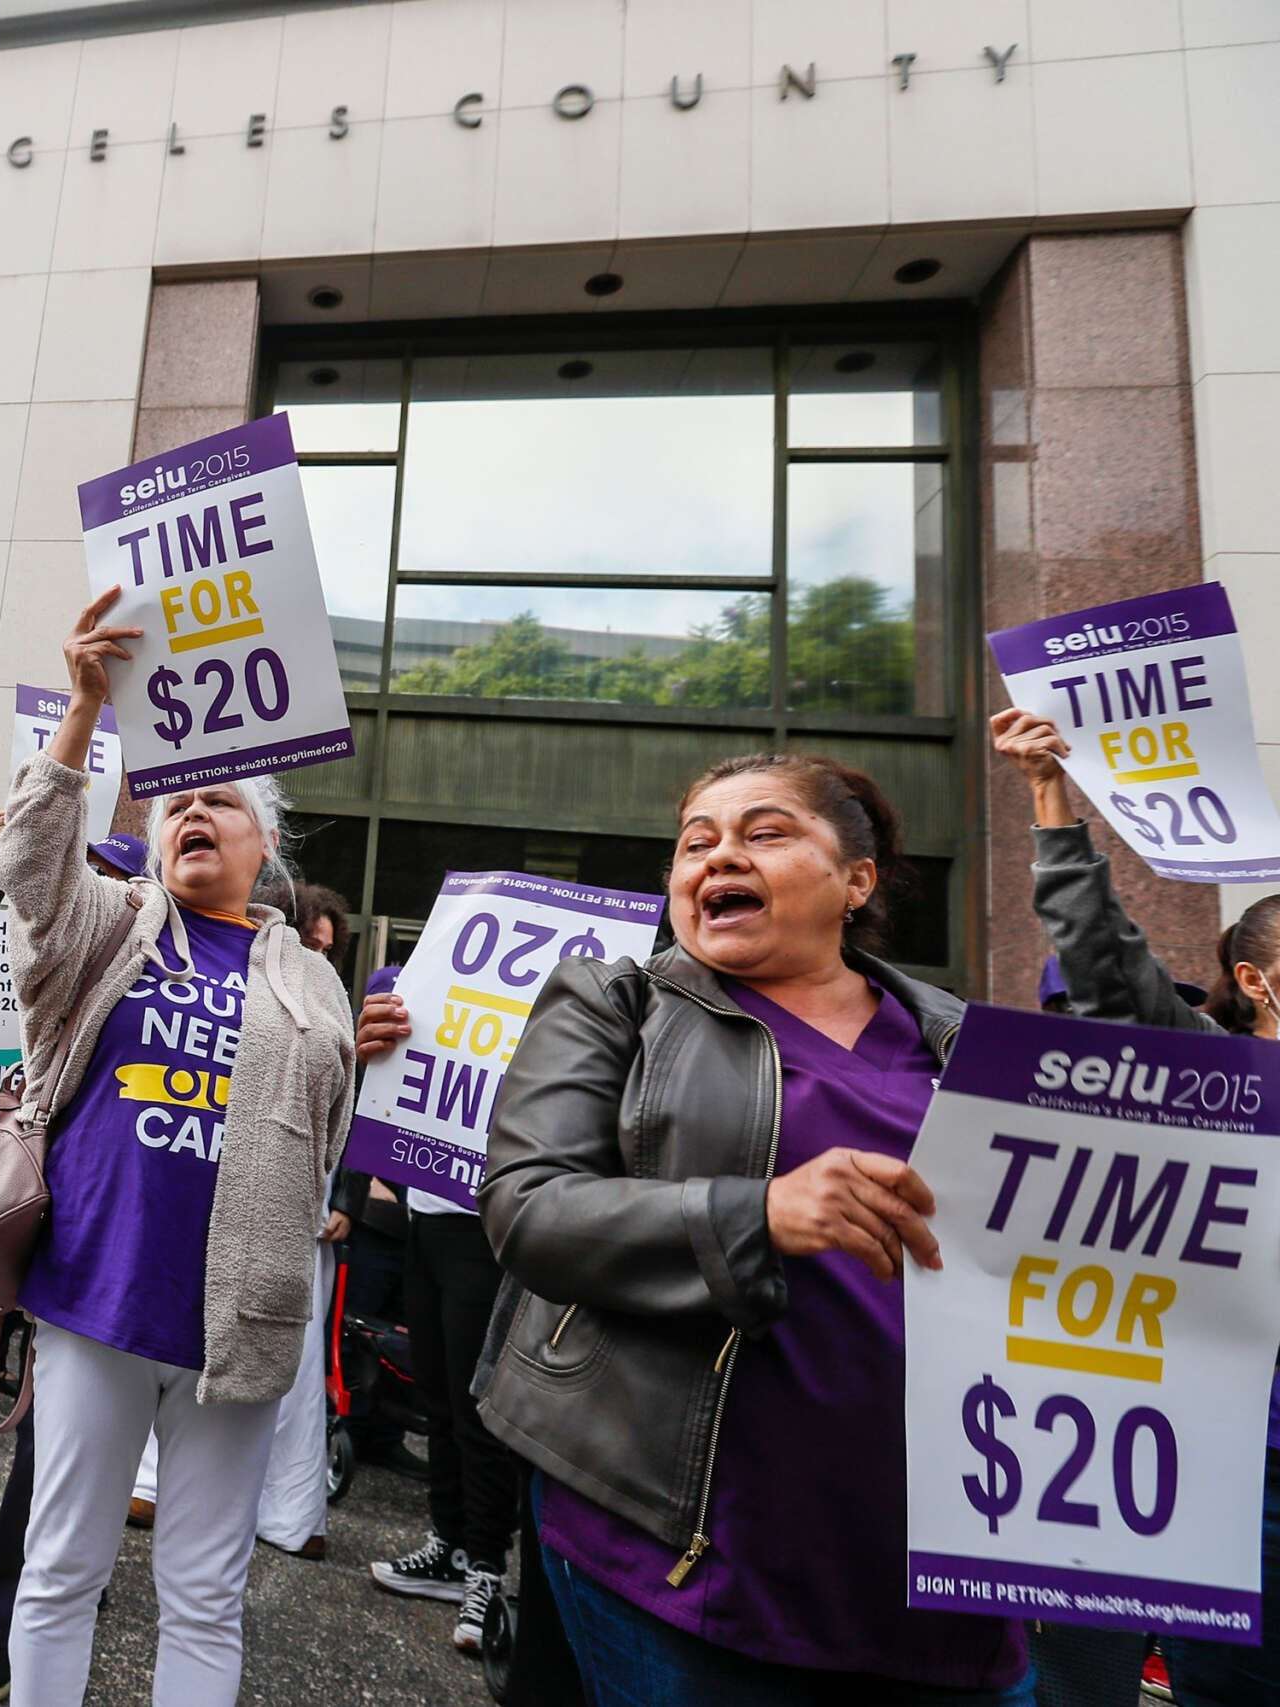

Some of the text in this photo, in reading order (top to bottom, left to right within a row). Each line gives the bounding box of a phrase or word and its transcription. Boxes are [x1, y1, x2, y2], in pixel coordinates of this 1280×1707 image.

[454, 43, 1018, 129] COUNTY
[123, 470, 251, 516] California's Long Term Caregivers
[118, 491, 274, 587] TIME
[160, 570, 260, 634] FOR
[147, 647, 290, 750] $20
[1050, 655, 1213, 729] TIME
[33, 727, 105, 774] TE
[134, 741, 348, 792] SIGN THE PETTION: seiu2015.org/timefor20
[1099, 721, 1195, 770] FOR
[1109, 786, 1238, 851] $20
[551, 887, 602, 904] PETTION:
[604, 897, 626, 909] THE
[629, 901, 658, 912] SIGN
[125, 974, 245, 1023] COU
[396, 1049, 504, 1134] ME
[1027, 1091, 1256, 1133] California's Long Term Caregivers
[985, 1132, 1259, 1269] TIME
[1008, 1254, 1178, 1350] FOR
[961, 1374, 1179, 1538] $20
[916, 1575, 1253, 1632] SIGN THE PETTION: seiu2015.org/timefor20
